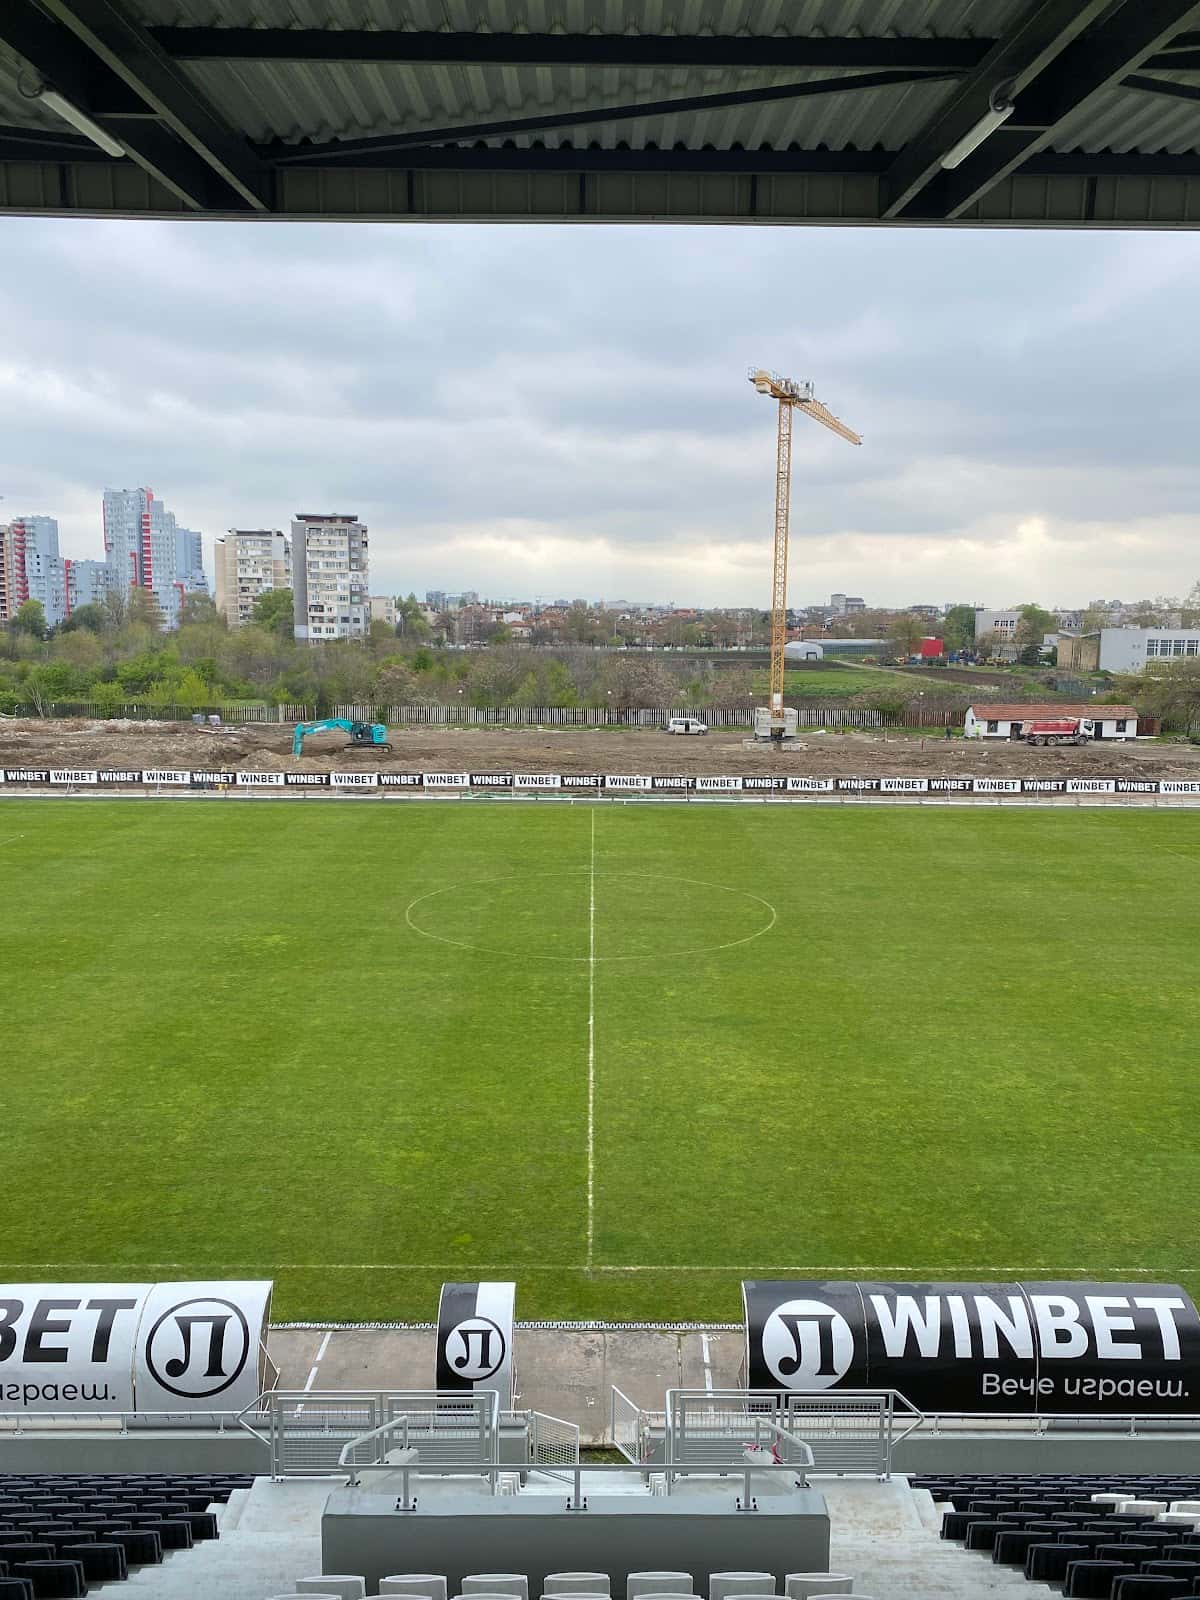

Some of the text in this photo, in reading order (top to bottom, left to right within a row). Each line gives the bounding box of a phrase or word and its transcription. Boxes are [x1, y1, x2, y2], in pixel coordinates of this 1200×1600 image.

[7, 772, 47, 781] WINBET
[54, 772, 95, 782] WINBET
[100, 772, 139, 782] WINBET
[146, 772, 186, 782] WINBET
[193, 773, 234, 783] WINBET
[241, 774, 280, 783] WINBET
[287, 775, 328, 784] WINBET
[334, 775, 374, 784] WINBET
[380, 775, 420, 784] WINBET
[427, 775, 467, 784] WINBET
[472, 776, 512, 785] WINBET
[518, 776, 559, 785] WINBET
[563, 776, 603, 786] WINBET
[609, 777, 648, 786] WINBET
[655, 777, 695, 787] WINBET
[700, 778, 738, 787] WINBET
[745, 778, 784, 788] WINBET
[791, 779, 829, 789] WINBET
[838, 780, 879, 789] WINBET
[884, 780, 924, 789] WINBET
[931, 780, 970, 790] WINBET
[977, 781, 1017, 790] WINBET
[1024, 781, 1064, 791] WINBET
[1071, 782, 1111, 791] WINBET
[1118, 782, 1157, 792] WINBET
[869, 1294, 1186, 1360] WINBET
[982, 1374, 1189, 1400] Вече играеш.
[0, 1384, 117, 1405] граеш.
